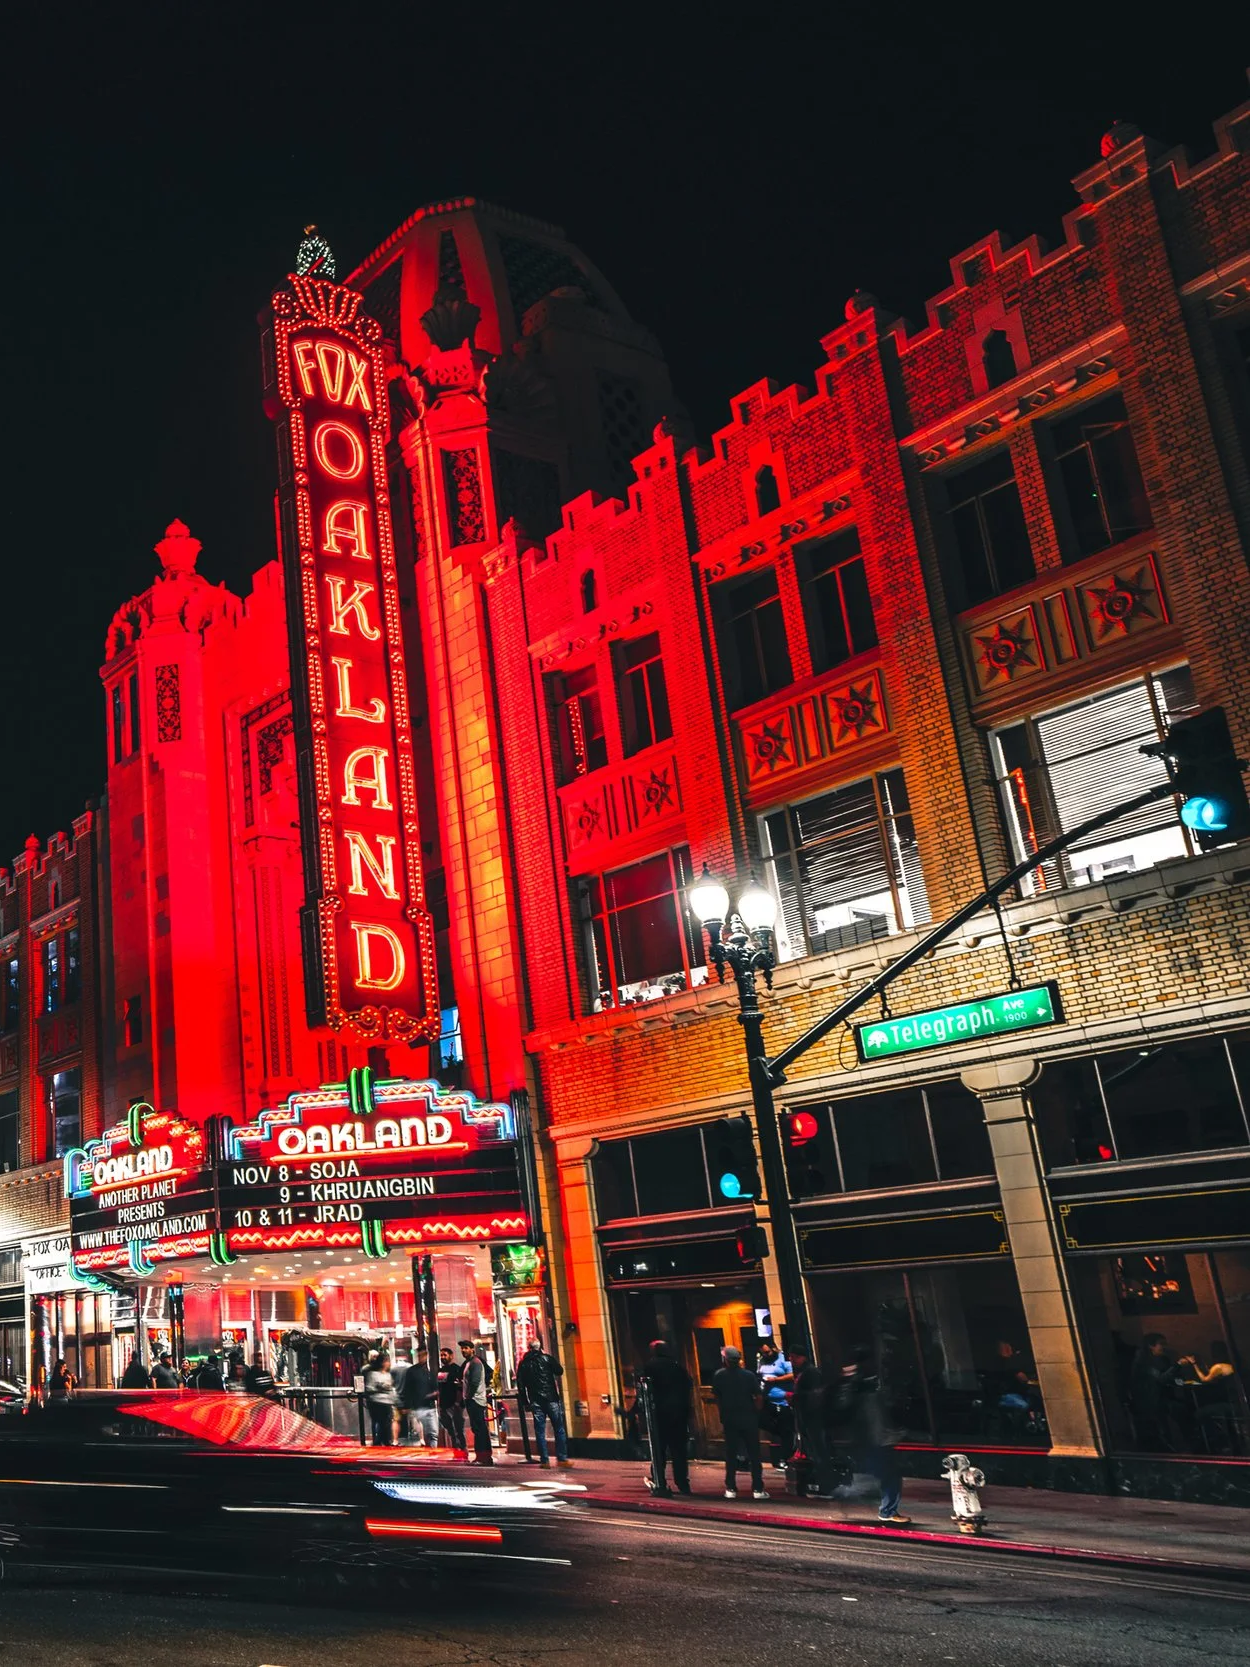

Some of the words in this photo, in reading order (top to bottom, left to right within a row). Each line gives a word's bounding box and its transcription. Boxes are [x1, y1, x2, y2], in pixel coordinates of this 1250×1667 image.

[292, 340, 373, 412] FOX
[313, 420, 406, 991] OAKLAND
[890, 1006, 996, 1045] Telegraph
[1002, 998, 1025, 1012] Ave
[1004, 1011, 1028, 1023] 1900
[278, 1115, 453, 1155] OAKLAND
[93, 1145, 173, 1185] OAKLAND
[233, 1166, 271, 1185] NOV
[278, 1165, 289, 1182] 8
[310, 1160, 360, 1180] SOJA
[98, 1185, 139, 1209] ANOTHER
[141, 1178, 177, 1200] PLANET
[280, 1187, 290, 1203] 9
[310, 1177, 435, 1201] KHRUANGBIN
[118, 1200, 165, 1224] PRESENTS
[234, 1210, 252, 1227] 10
[259, 1208, 271, 1226] &
[277, 1207, 293, 1225] 11
[313, 1204, 363, 1223] JRAD
[79, 1213, 207, 1249] WWW.THEFOXOAKLAND.COM
